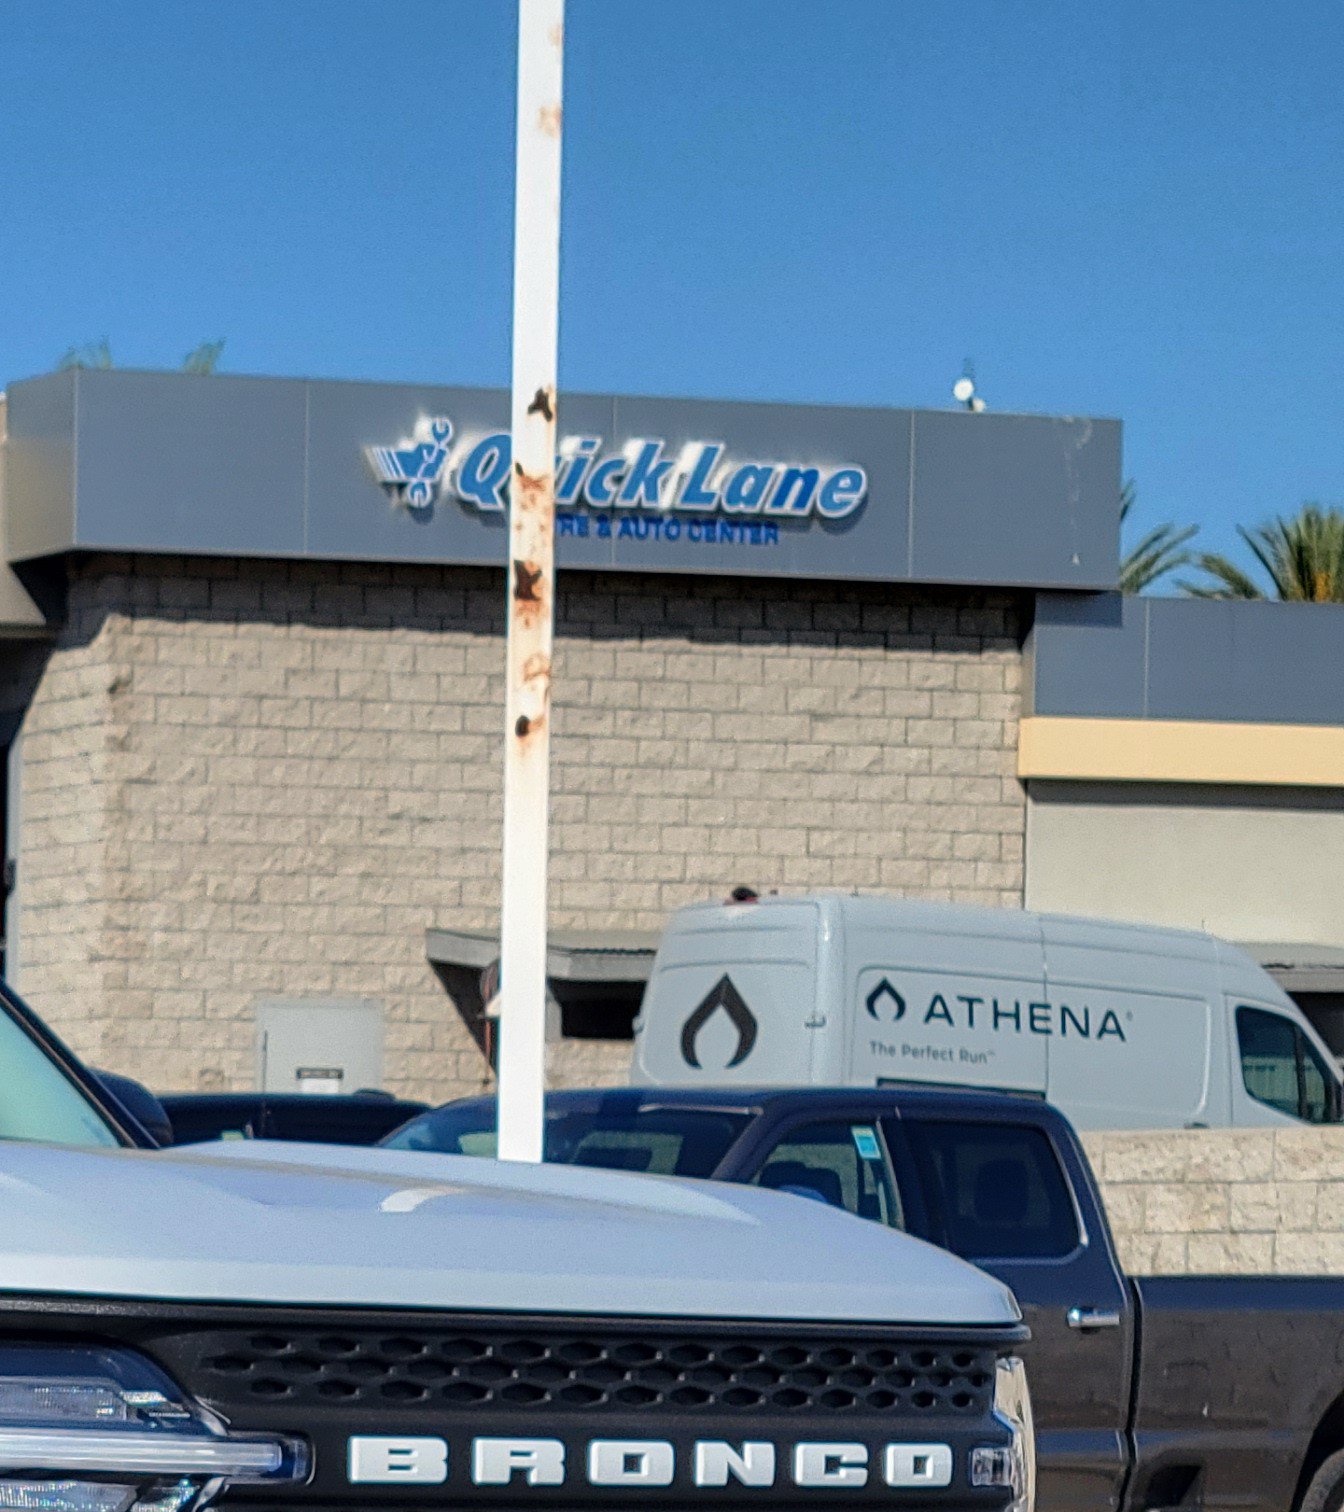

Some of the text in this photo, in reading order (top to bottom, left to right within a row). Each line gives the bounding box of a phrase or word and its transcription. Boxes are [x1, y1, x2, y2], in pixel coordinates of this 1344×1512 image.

[456, 432, 867, 519] Qick Lane
[596, 514, 611, 539] &
[619, 515, 681, 542] AUTO
[687, 517, 779, 546] CENTER
[923, 993, 1127, 1043] ATHENA
[869, 1040, 896, 1058] The
[901, 1043, 955, 1064] Perfect
[347, 1435, 954, 1488] BRONCO
